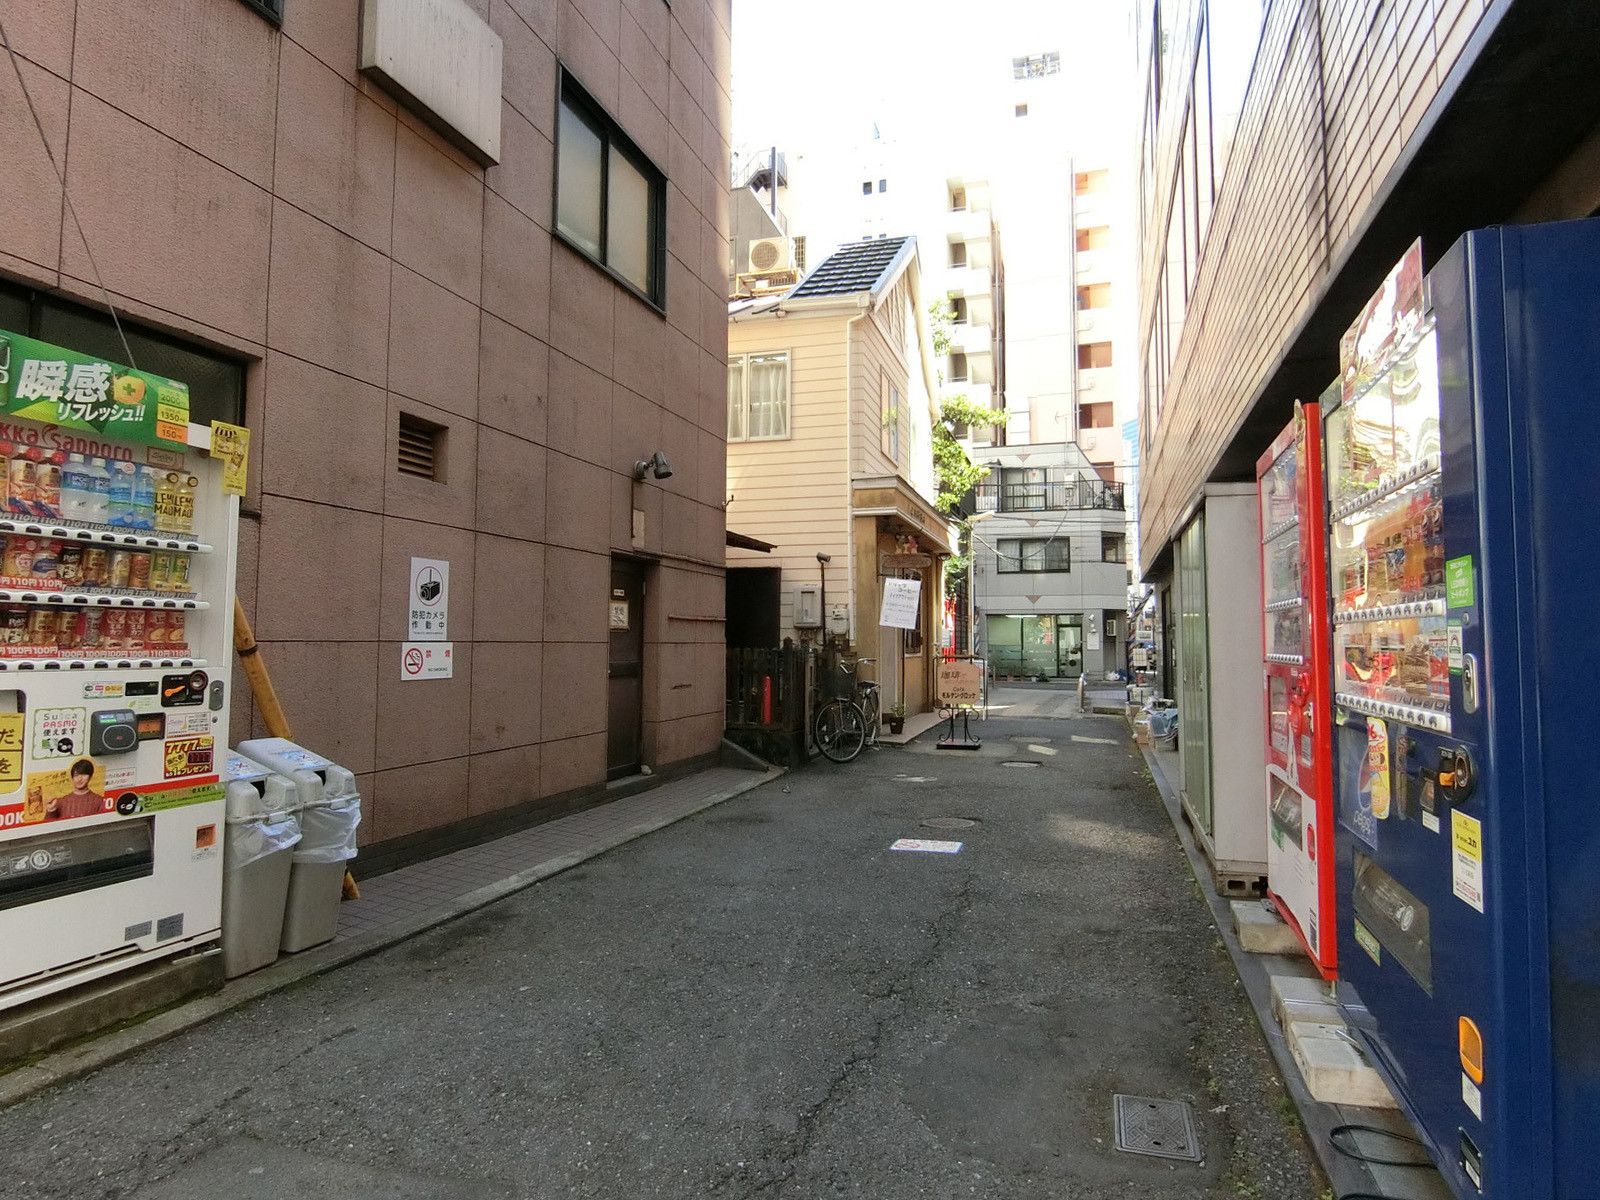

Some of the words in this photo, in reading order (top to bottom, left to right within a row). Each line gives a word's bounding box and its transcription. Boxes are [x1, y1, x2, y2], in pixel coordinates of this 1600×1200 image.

[15, 359, 112, 402] 瞬感
[12, 577, 37, 587] 110円
[38, 578, 63, 588] 110円
[411, 610, 445, 620] 防犯カメラ
[411, 620, 445, 630] 作動中
[7, 646, 33, 655] 100円
[33, 646, 58, 655] 100円
[42, 720, 77, 728] PASMO
[43, 727, 77, 737] 使えます
[166, 739, 198, 754] 7777
